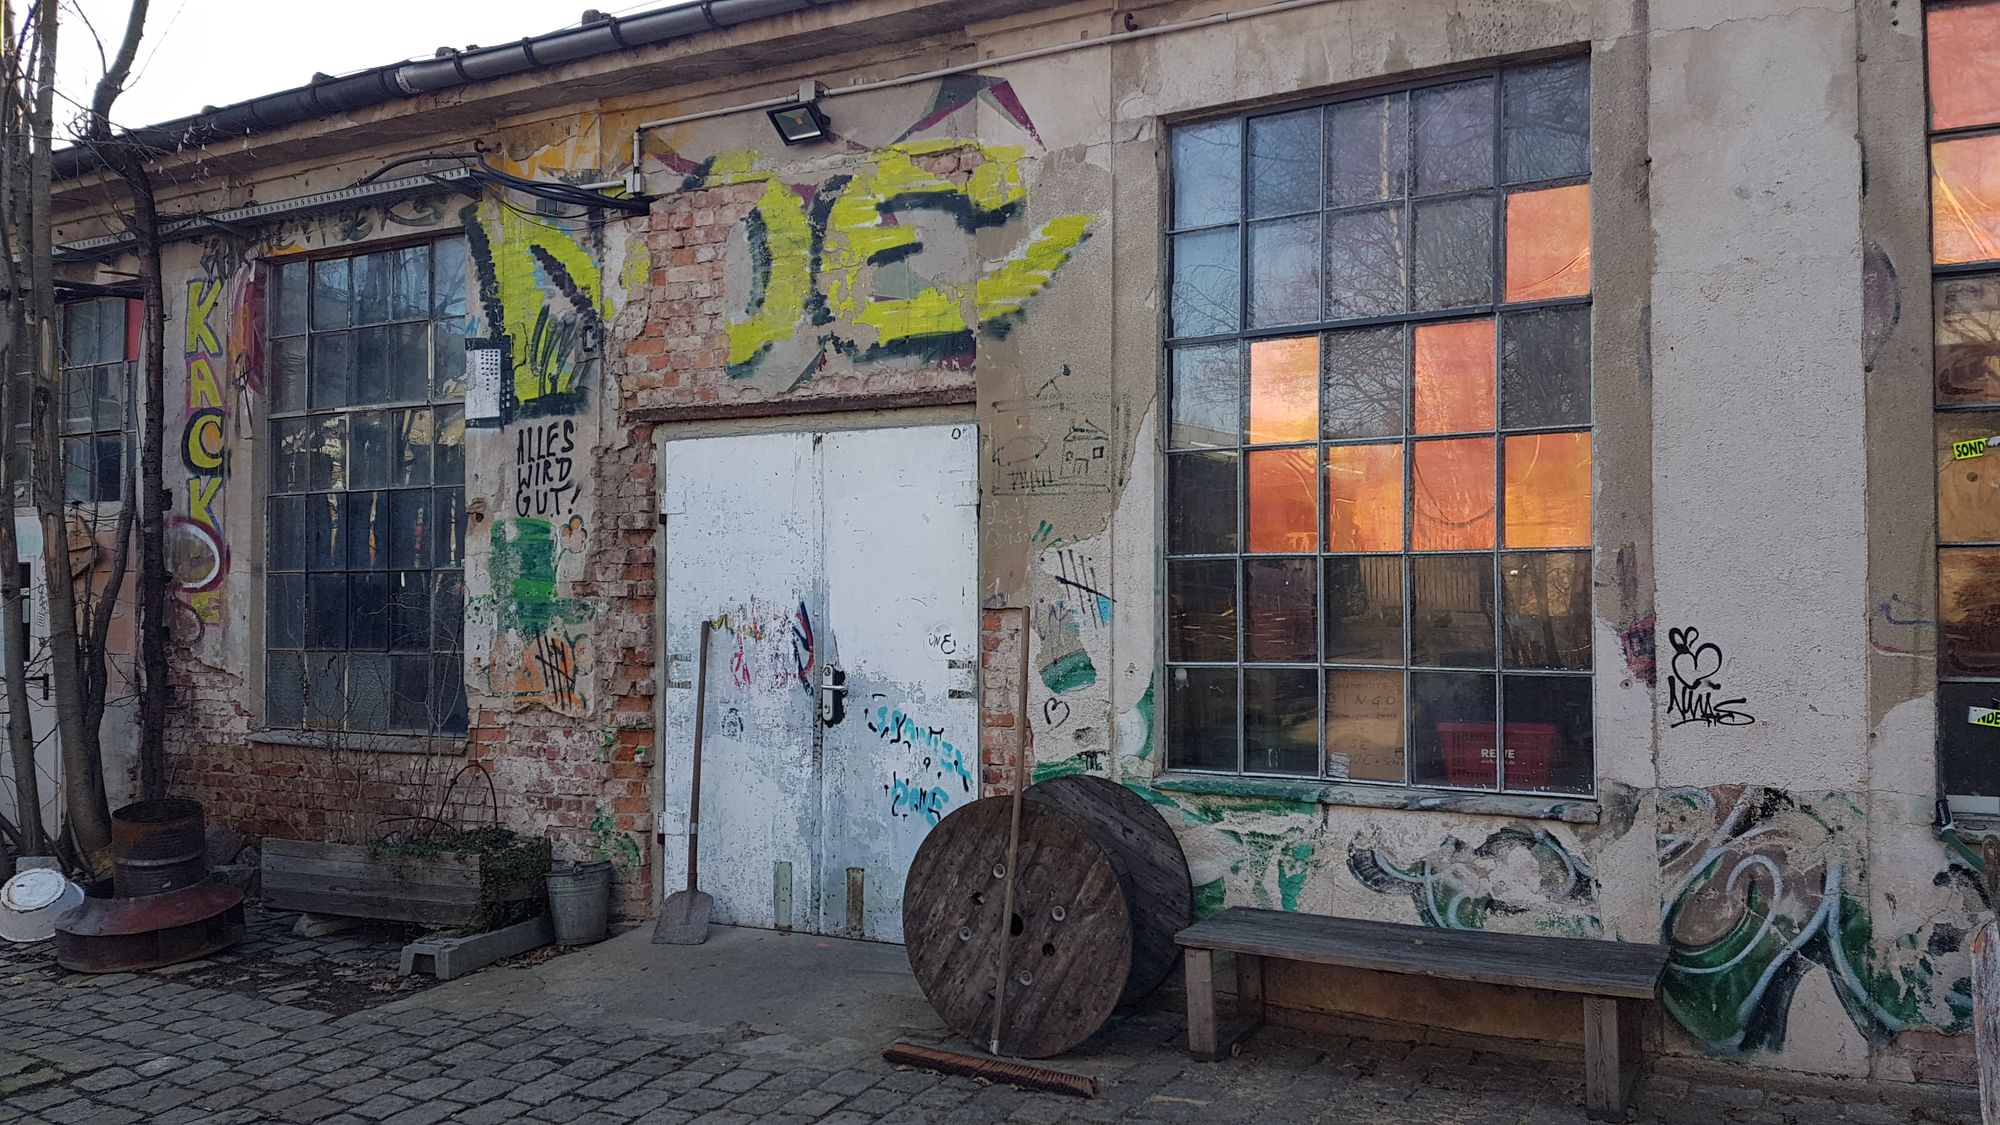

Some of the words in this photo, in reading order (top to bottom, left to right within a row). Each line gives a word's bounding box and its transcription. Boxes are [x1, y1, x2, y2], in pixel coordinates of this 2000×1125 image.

[516, 419, 575, 466] ALLES
[1956, 440, 1988, 458] SOND
[517, 457, 573, 489] WIRD
